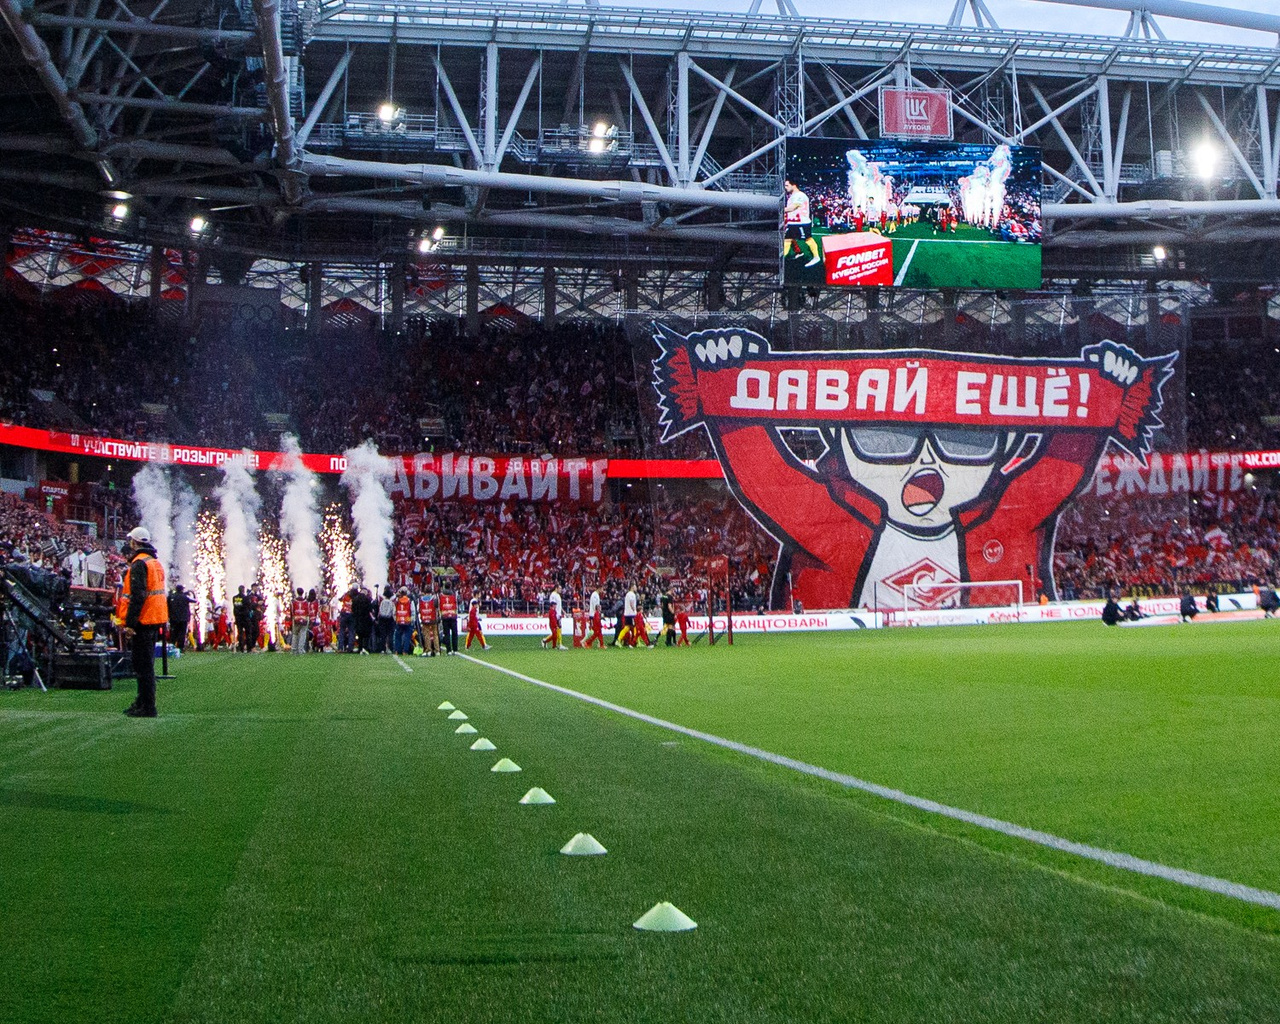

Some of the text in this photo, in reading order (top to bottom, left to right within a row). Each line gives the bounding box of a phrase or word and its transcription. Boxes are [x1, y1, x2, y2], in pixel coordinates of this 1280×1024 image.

[832, 258, 889, 280] КУБОК РОССИИ
[837, 248, 886, 269] FONBET
[730, 361, 1090, 418] ДАВАЙ ЕЩЁ!
[384, 452, 608, 502] АБИВАЙТЕ
[1096, 448, 1243, 497] ЕЖДАЙТЕ
[1040, 608, 1062, 619] НЕ
[1068, 605, 1103, 619] ТОЛЬ
[731, 617, 828, 631] КАНЦТОВАРЫ
